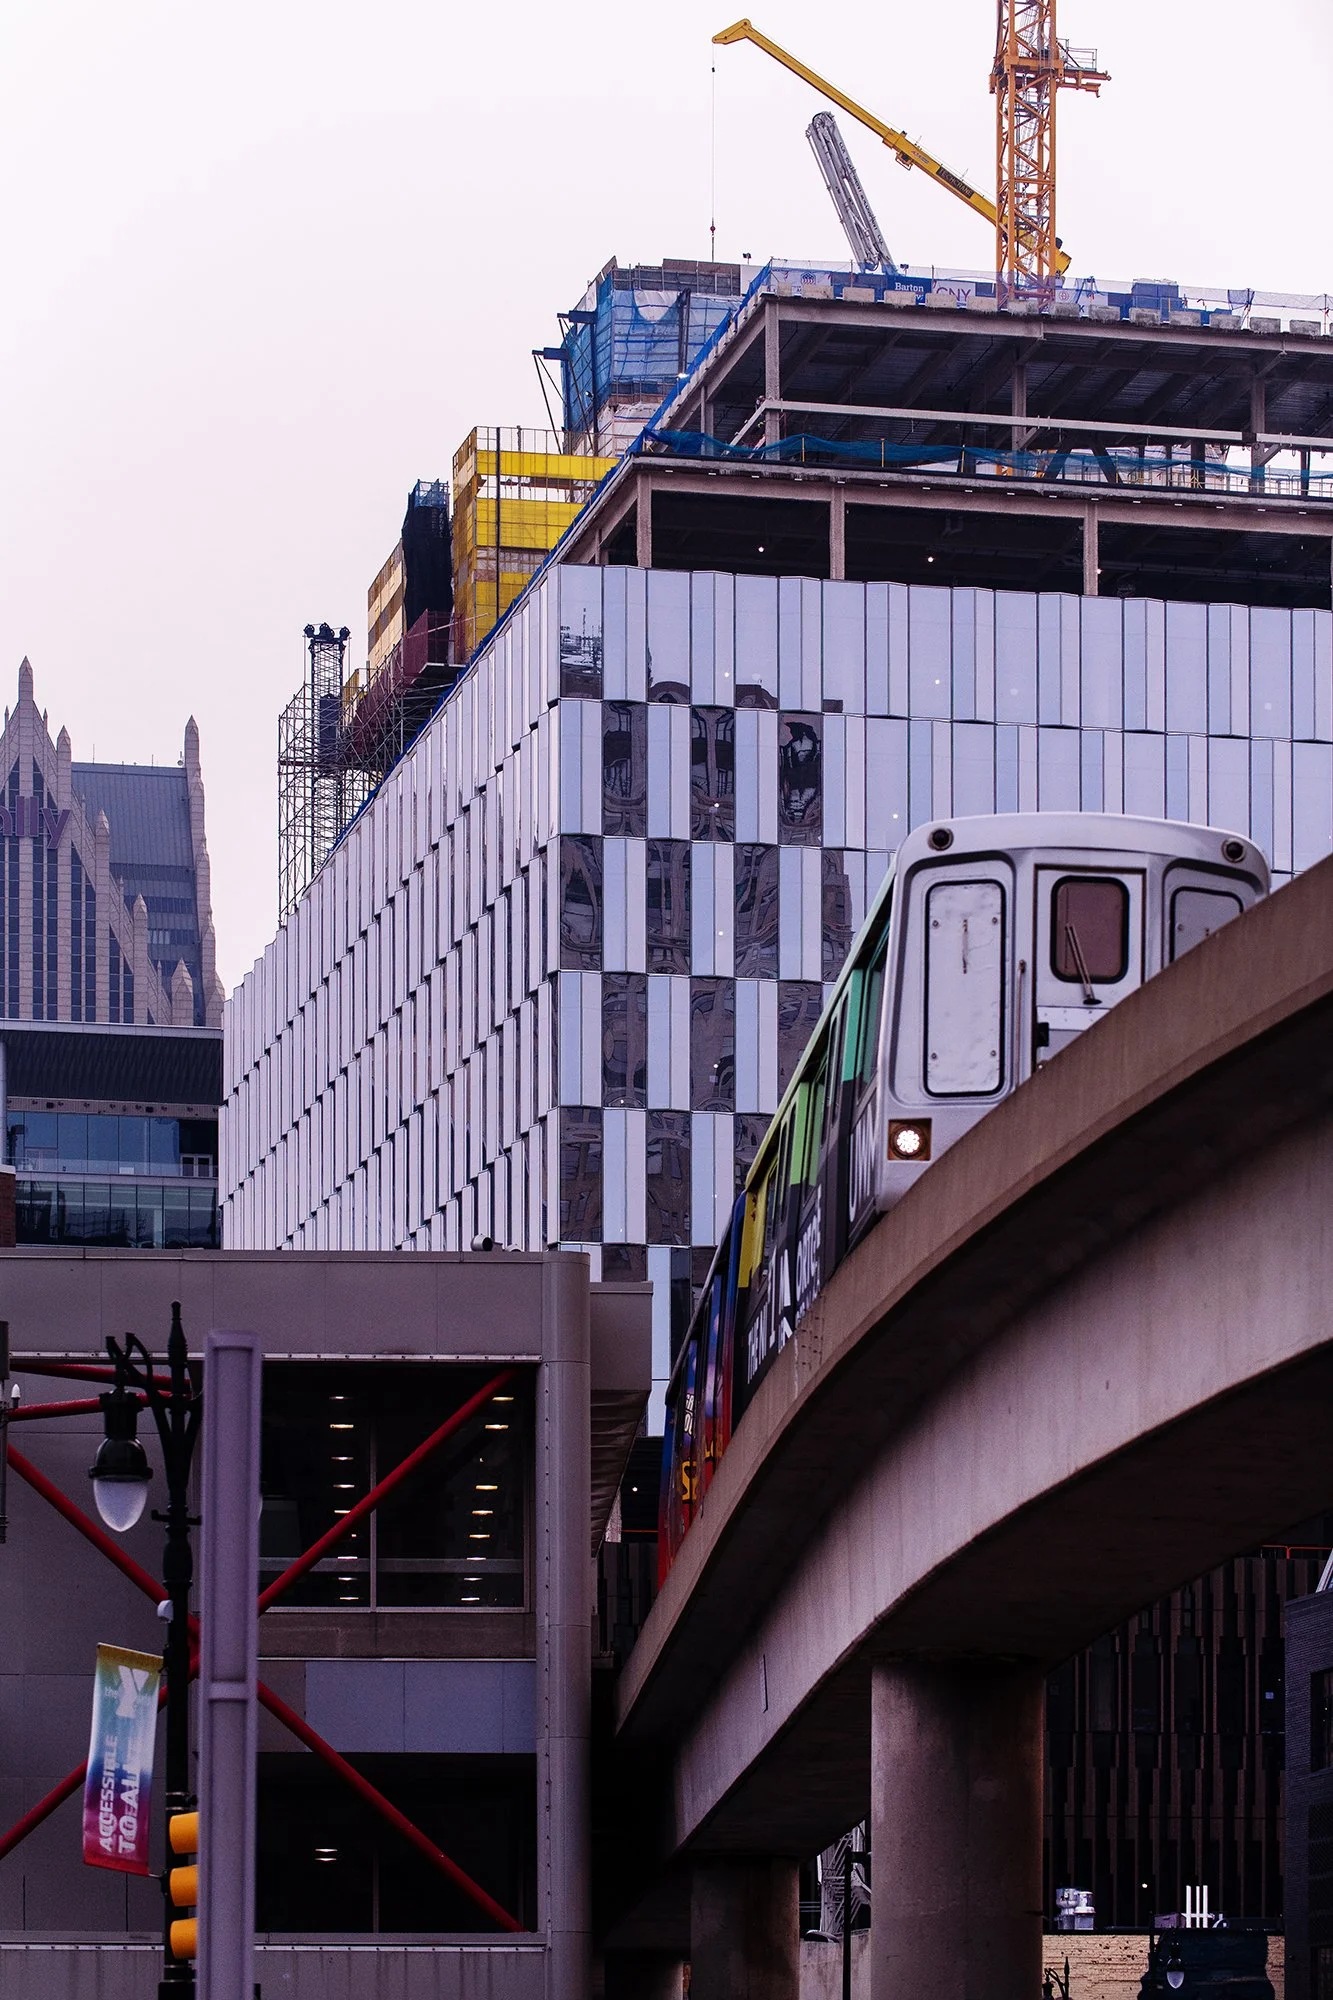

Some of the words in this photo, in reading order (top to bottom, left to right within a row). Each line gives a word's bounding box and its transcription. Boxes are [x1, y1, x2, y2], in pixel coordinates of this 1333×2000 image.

[895, 282, 924, 292] Barton
[100, 1734, 118, 1853] ACCESSIBLE
[118, 1814, 138, 1854] TO
